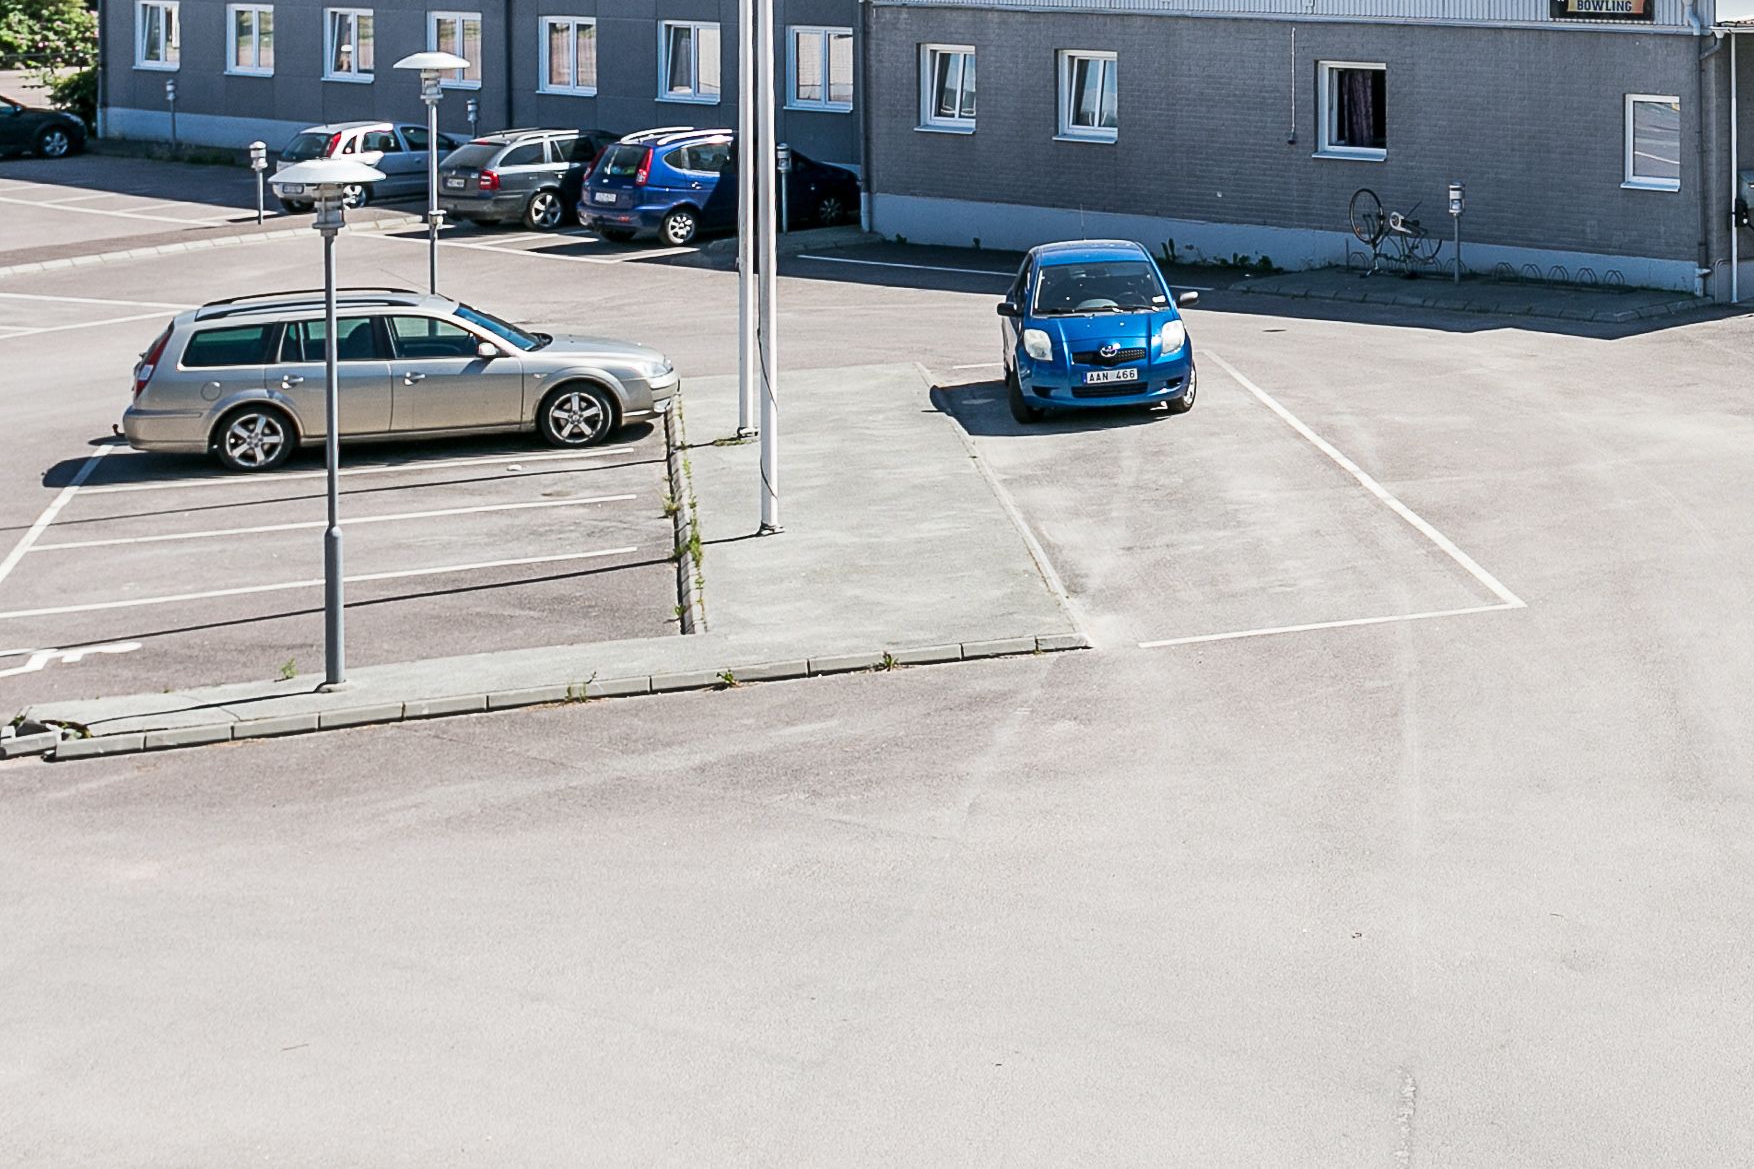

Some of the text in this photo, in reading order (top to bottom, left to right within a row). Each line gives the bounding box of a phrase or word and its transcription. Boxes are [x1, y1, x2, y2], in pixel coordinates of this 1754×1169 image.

[1577, 0, 1632, 12] BOWLING
[1089, 370, 1135, 382] AAN 466
